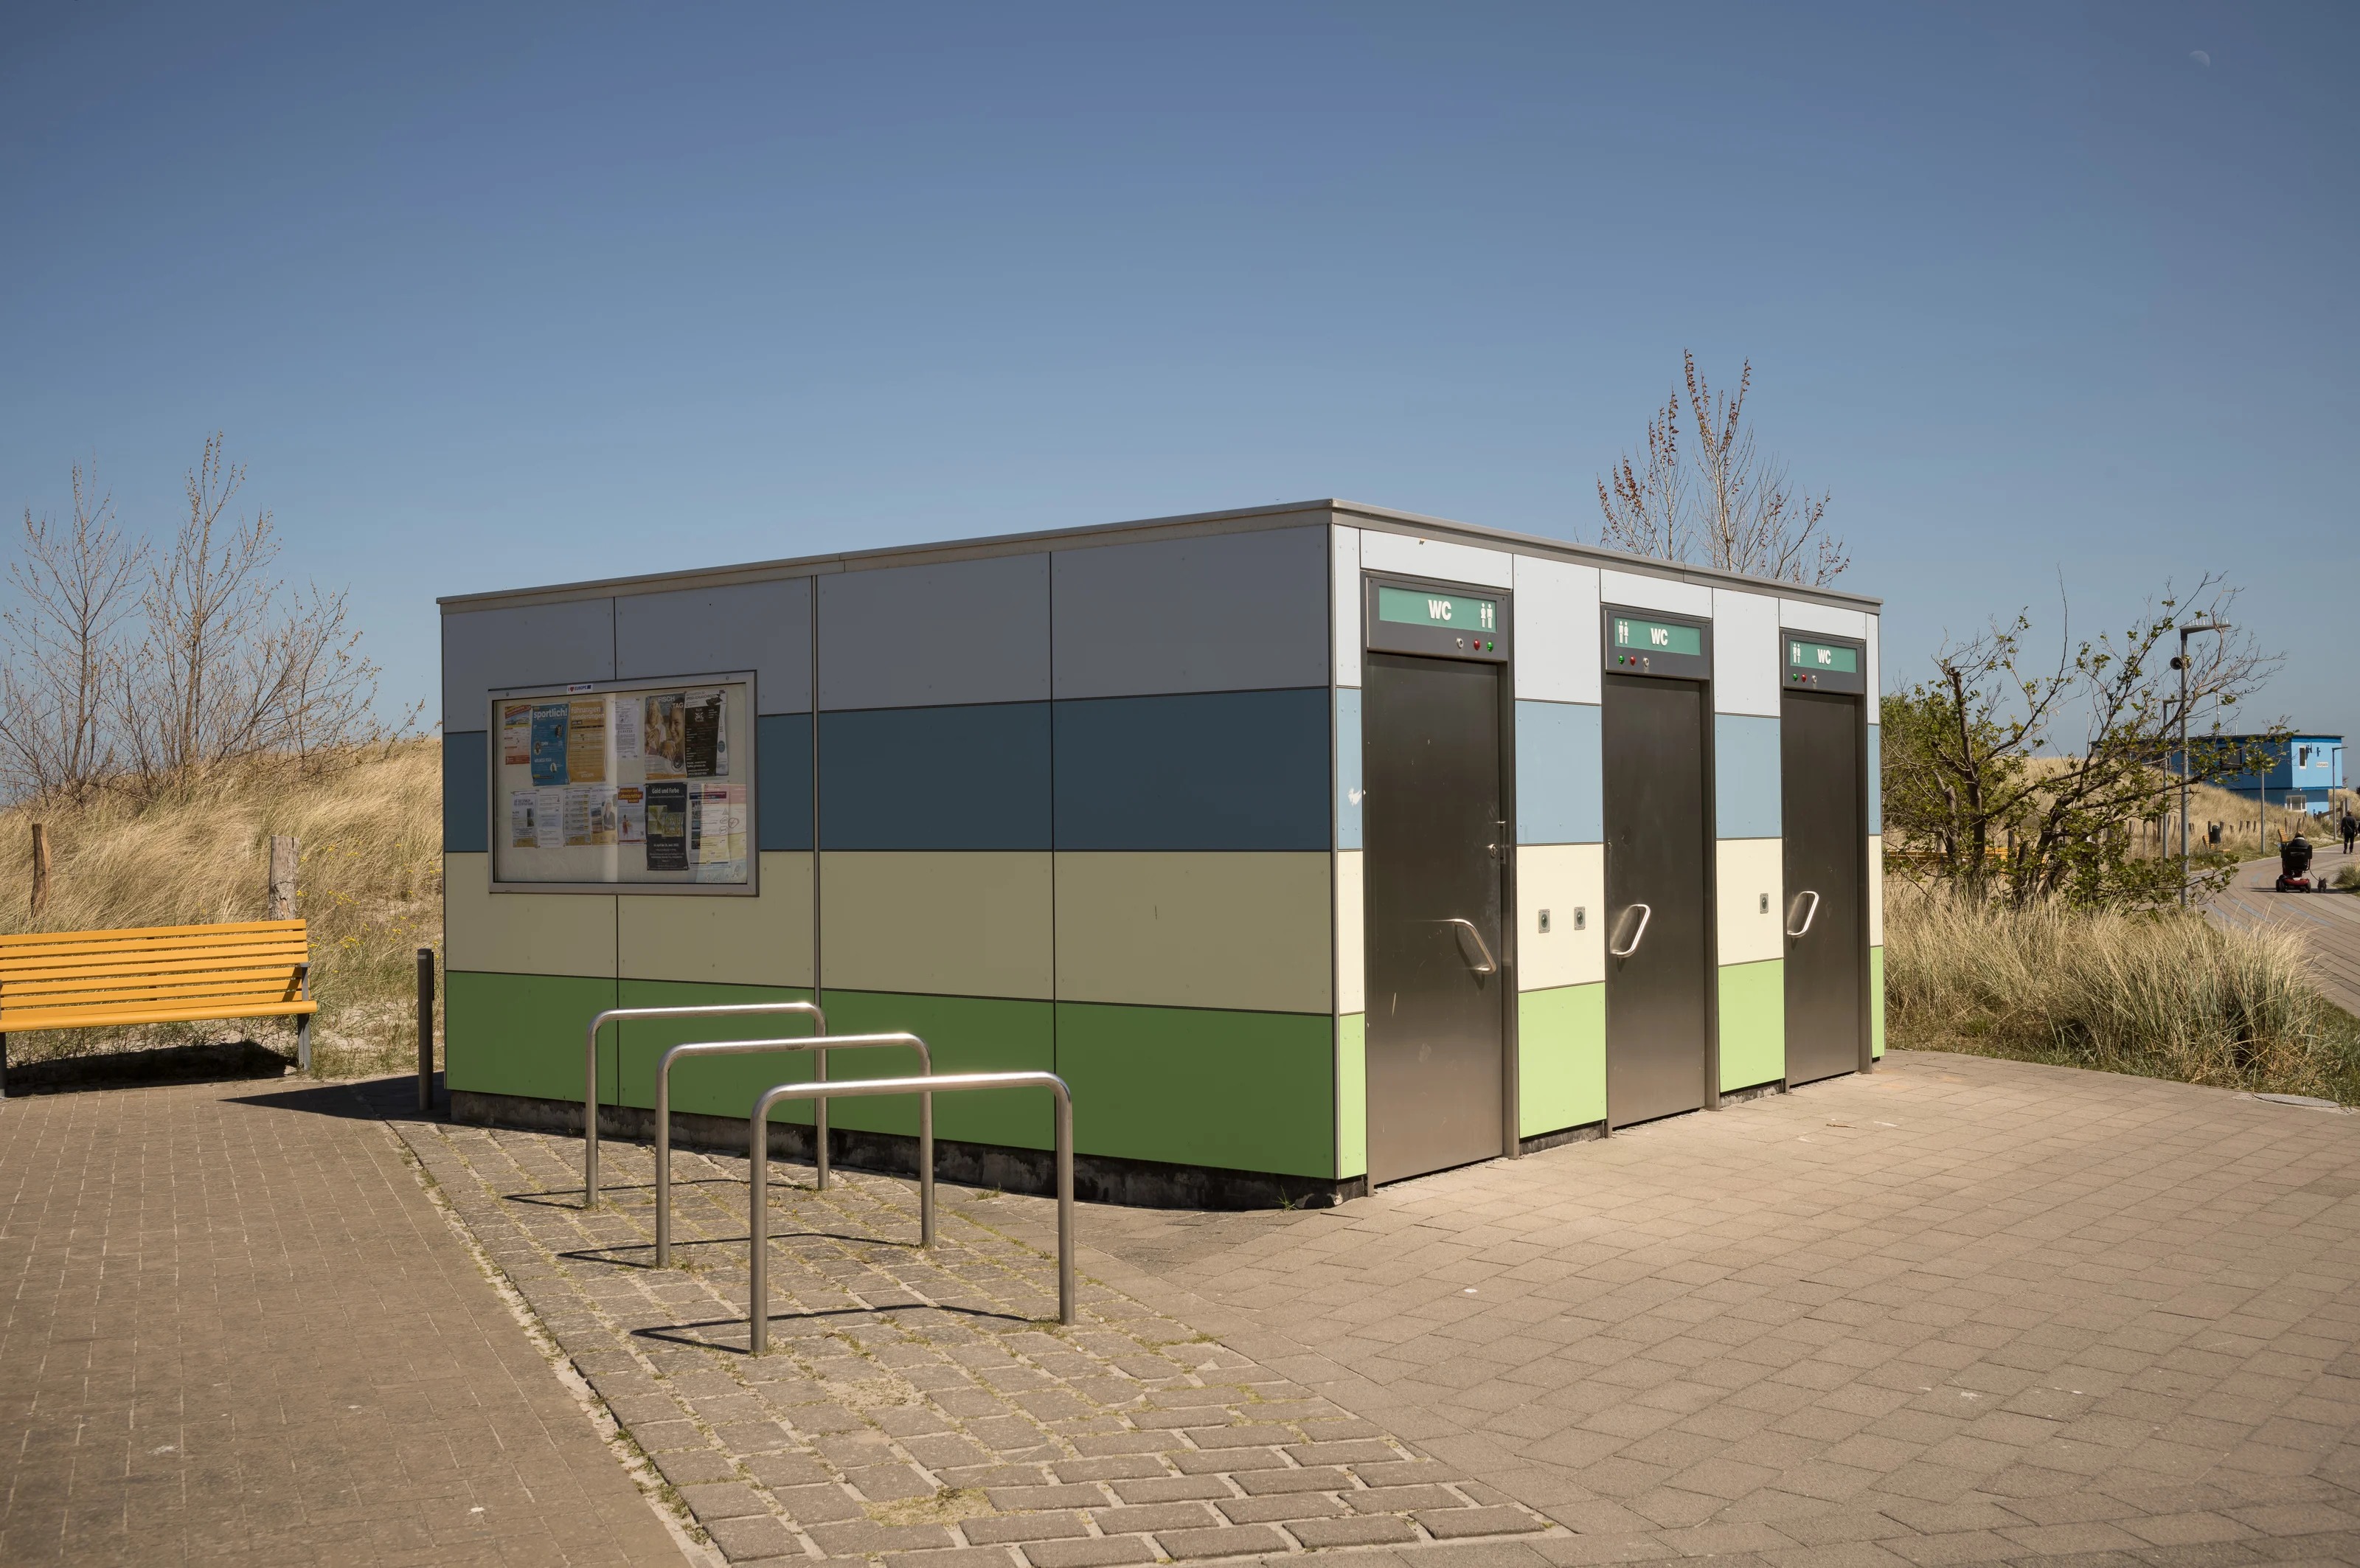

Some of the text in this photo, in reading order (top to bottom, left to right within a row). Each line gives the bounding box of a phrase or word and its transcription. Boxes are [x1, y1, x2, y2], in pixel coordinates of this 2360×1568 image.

[1428, 599, 1452, 621] WC
[1651, 628, 1668, 646] WC
[1817, 648, 1831, 665] WC
[533, 707, 568, 720] sportlich!
